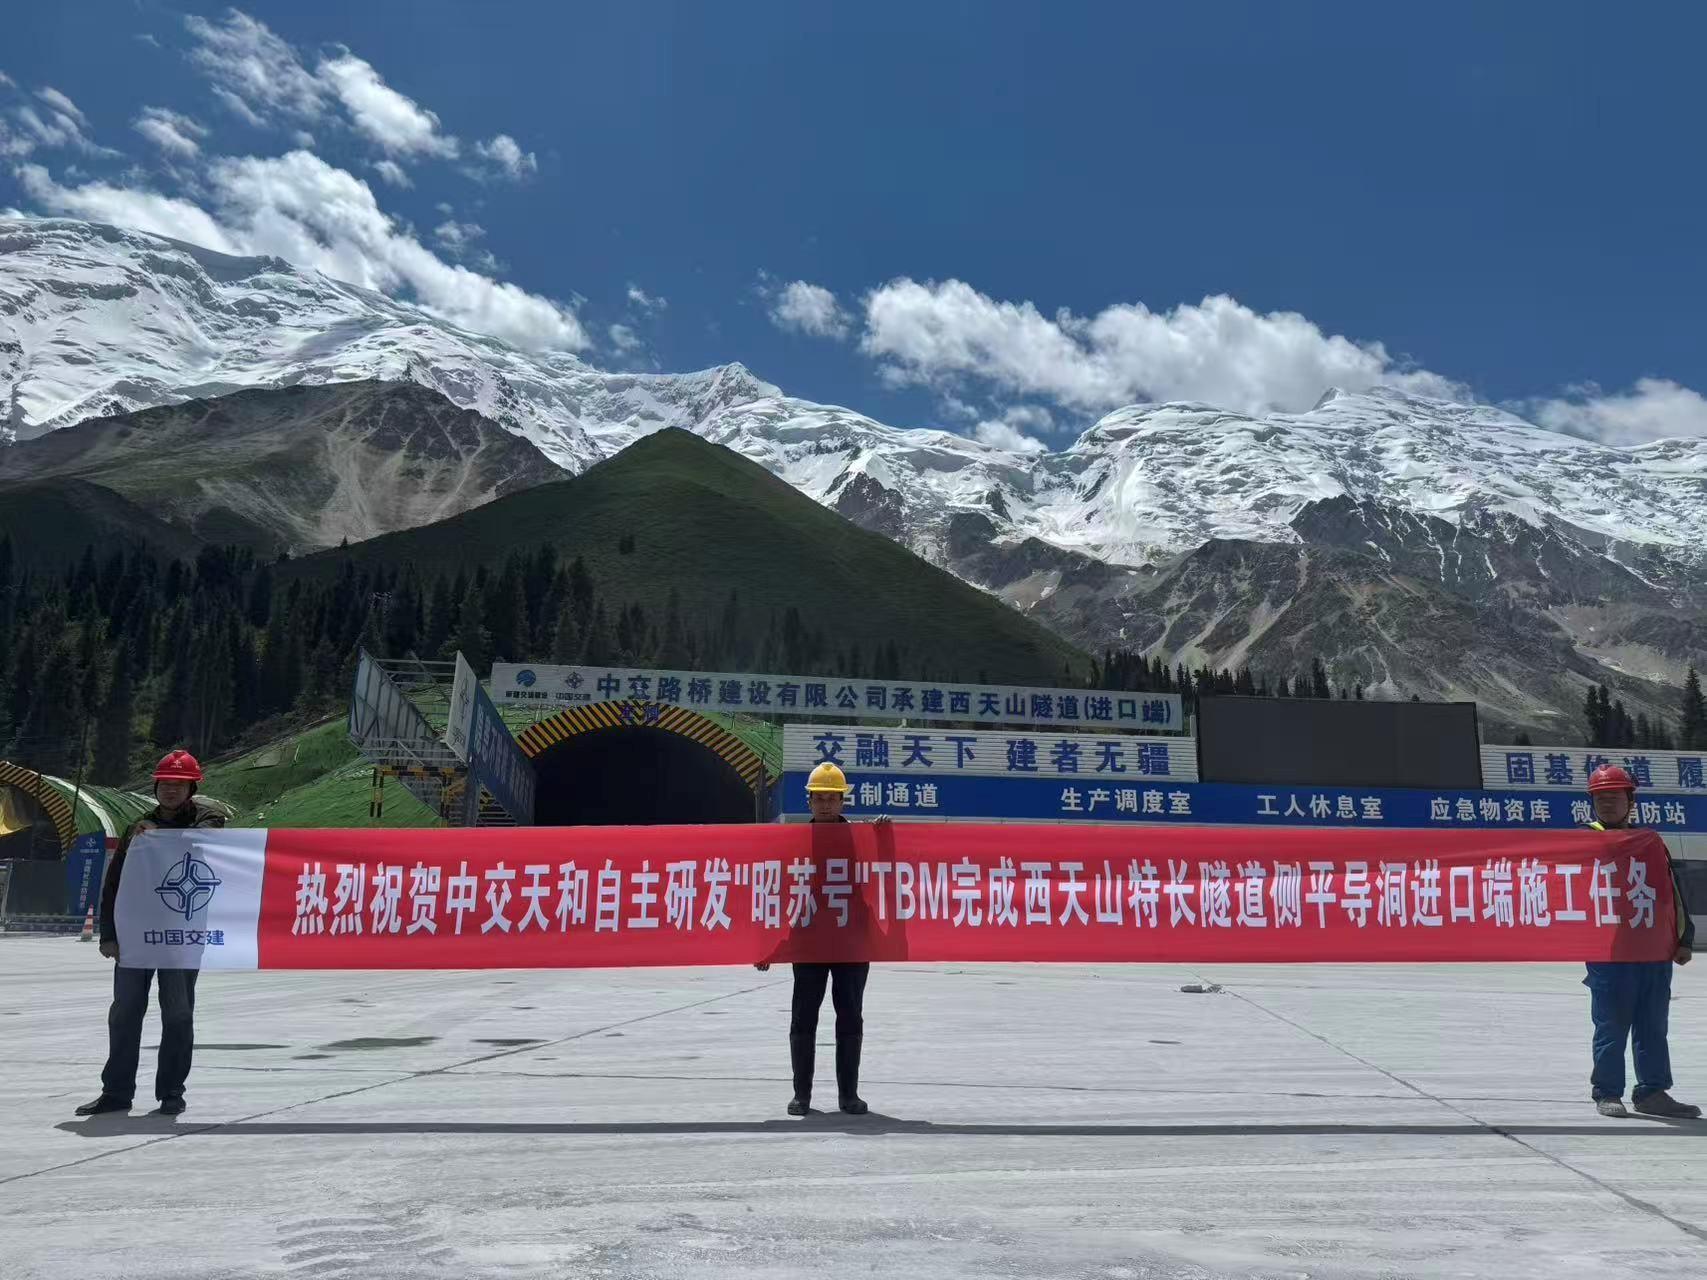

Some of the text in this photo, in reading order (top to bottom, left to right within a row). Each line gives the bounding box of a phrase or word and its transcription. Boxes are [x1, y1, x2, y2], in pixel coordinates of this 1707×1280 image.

[597, 673, 1171, 724] 中交路桥建设有限公司承建西天山隧道(进口端)
[812, 732, 1171, 775] 交融天下 建者无疆
[806, 781, 939, 808] 名制通道
[1061, 787, 1193, 815] 生产调度室
[1256, 794, 1384, 820] 工人休息室
[1430, 797, 1551, 823] 应急物资库
[1571, 799, 1686, 825] 微防站
[144, 929, 225, 946] 中国交建
